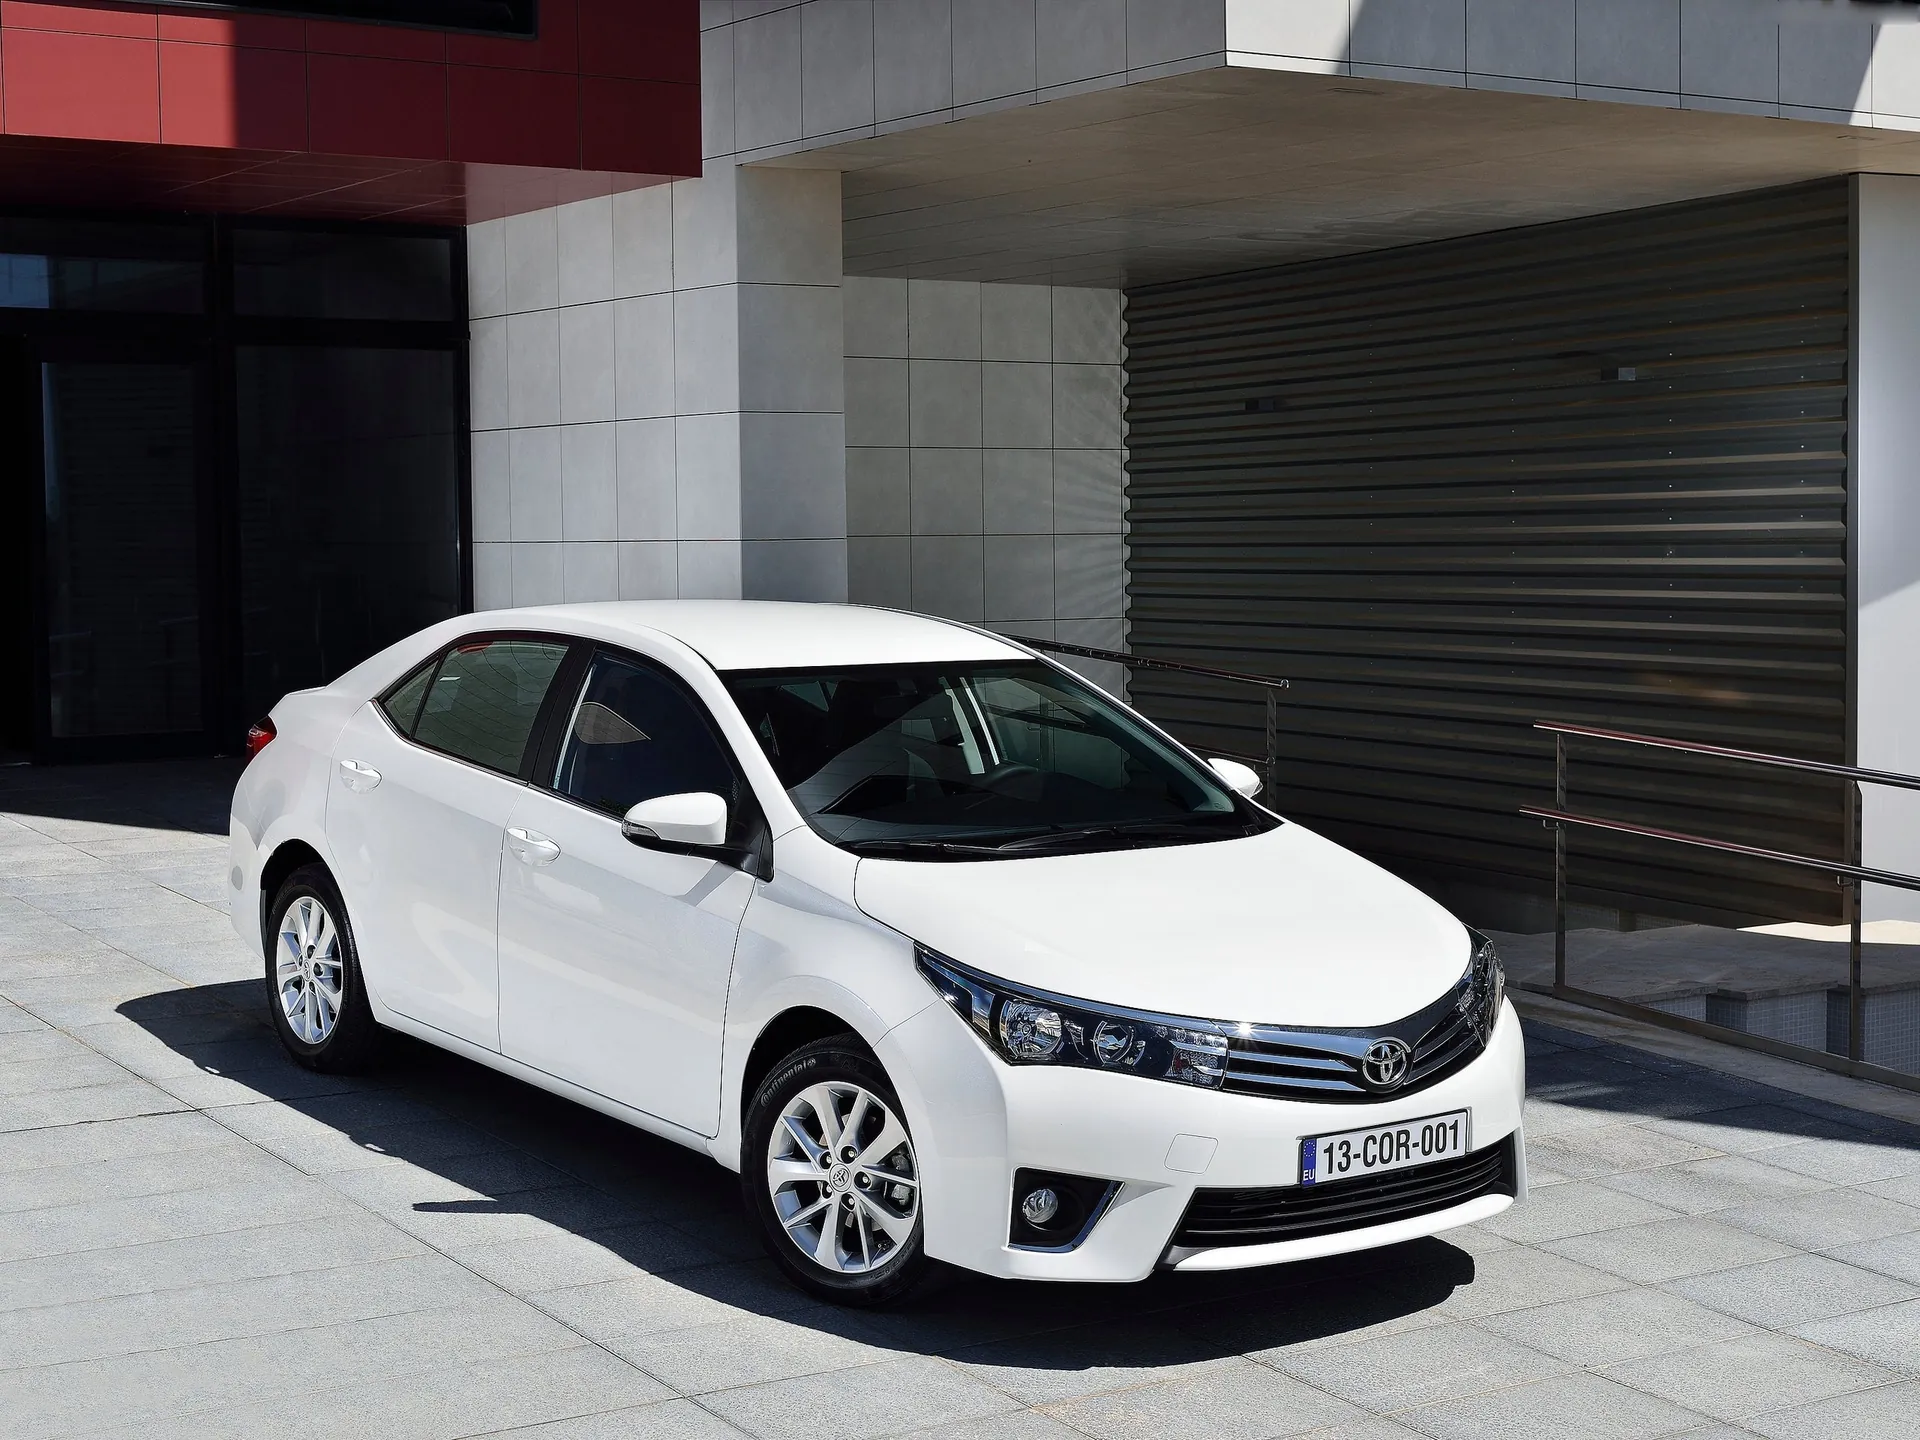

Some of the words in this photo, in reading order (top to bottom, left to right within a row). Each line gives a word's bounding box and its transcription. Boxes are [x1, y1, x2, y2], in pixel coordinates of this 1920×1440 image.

[760, 1060, 808, 1108] Continental
[1323, 1119, 1459, 1175] 13-COR-001
[1303, 1169, 1315, 1181] EU
